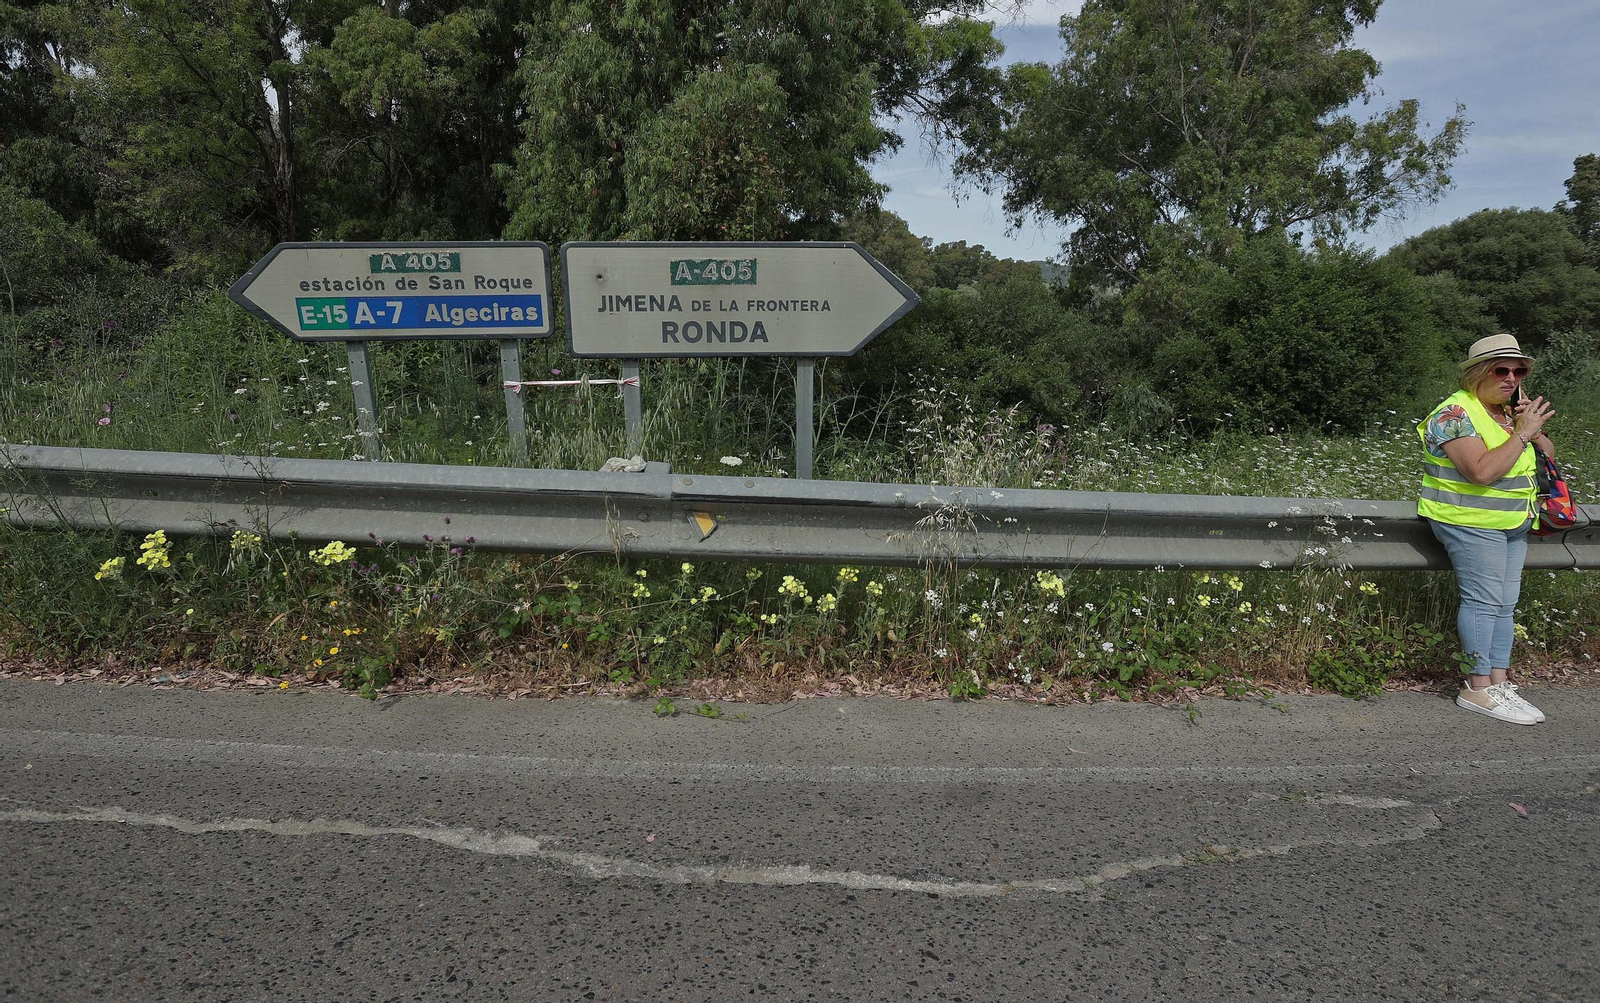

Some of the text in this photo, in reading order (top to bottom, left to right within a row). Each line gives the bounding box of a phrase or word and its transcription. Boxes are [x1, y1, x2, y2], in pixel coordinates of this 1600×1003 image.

[380, 253, 451, 270] A 405
[674, 261, 754, 281] A-405
[299, 275, 534, 293] estación de San Roque
[597, 294, 832, 313] JIMENA DE LA FRONTERA
[300, 301, 539, 326] E-15 A-7 Algeciras
[661, 320, 770, 344] RONDA
